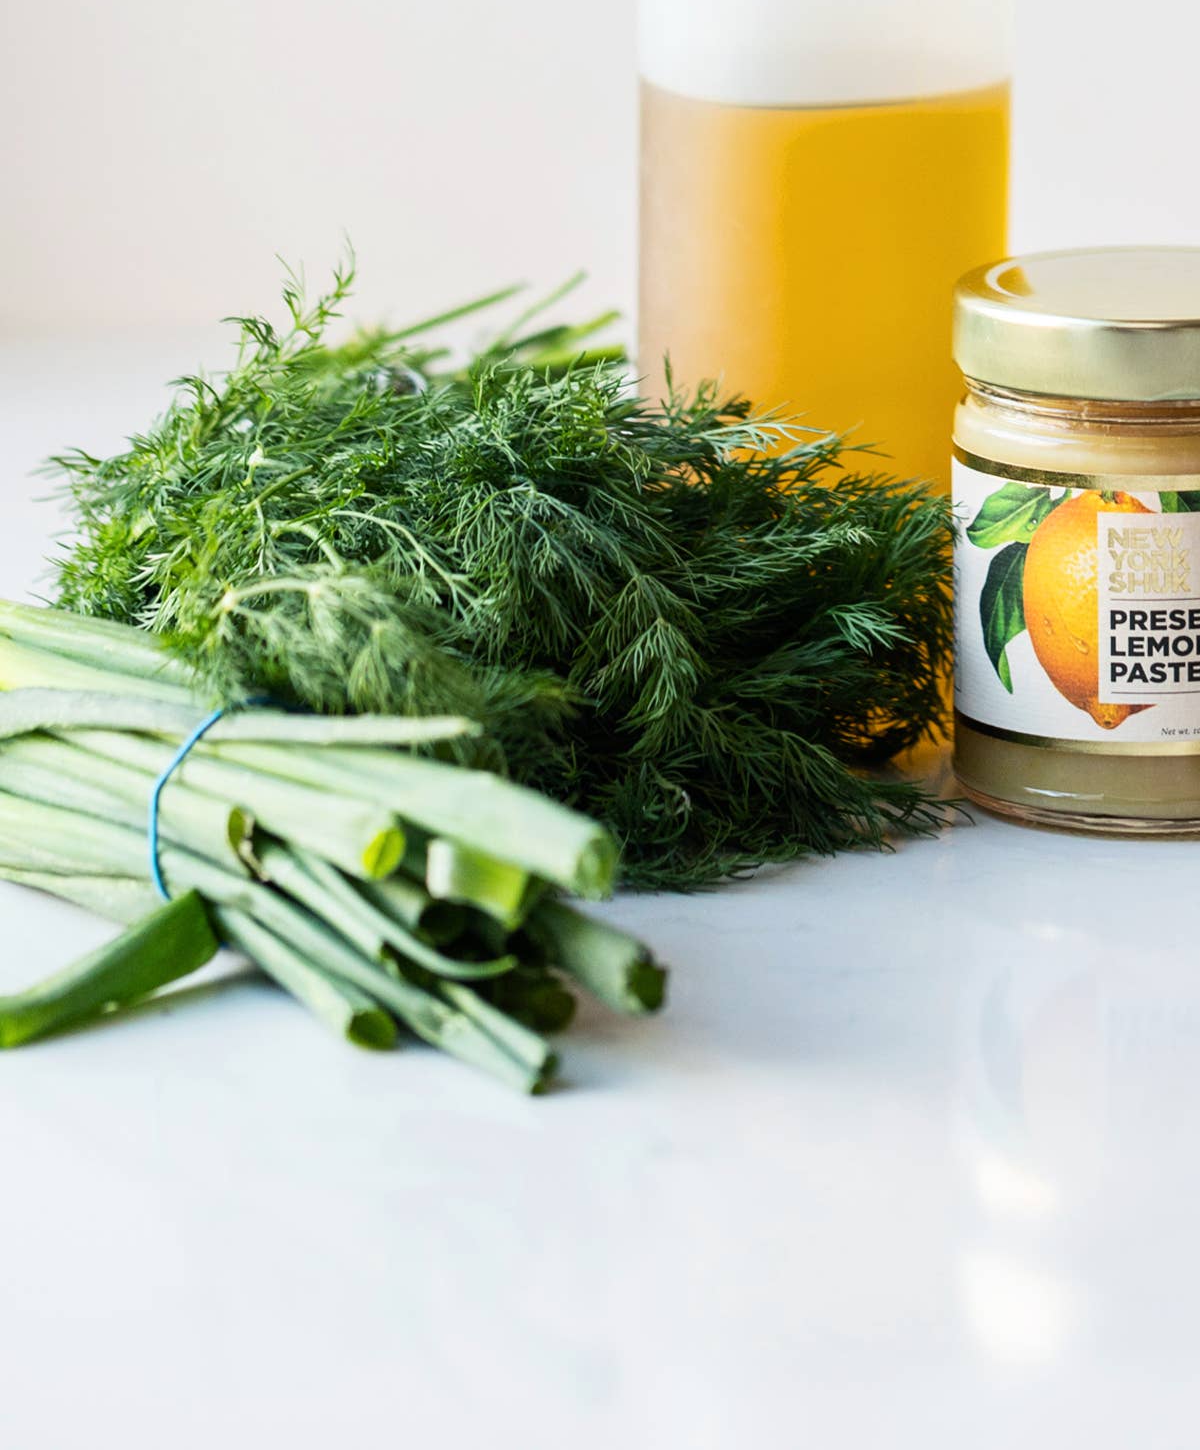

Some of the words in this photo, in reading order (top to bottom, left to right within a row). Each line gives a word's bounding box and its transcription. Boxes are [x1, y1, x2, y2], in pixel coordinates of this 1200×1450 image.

[1107, 527, 1184, 548] NEW
[1108, 550, 1190, 571] YORK
[1108, 571, 1191, 593] SHUK
[1161, 727, 1176, 735] Net
